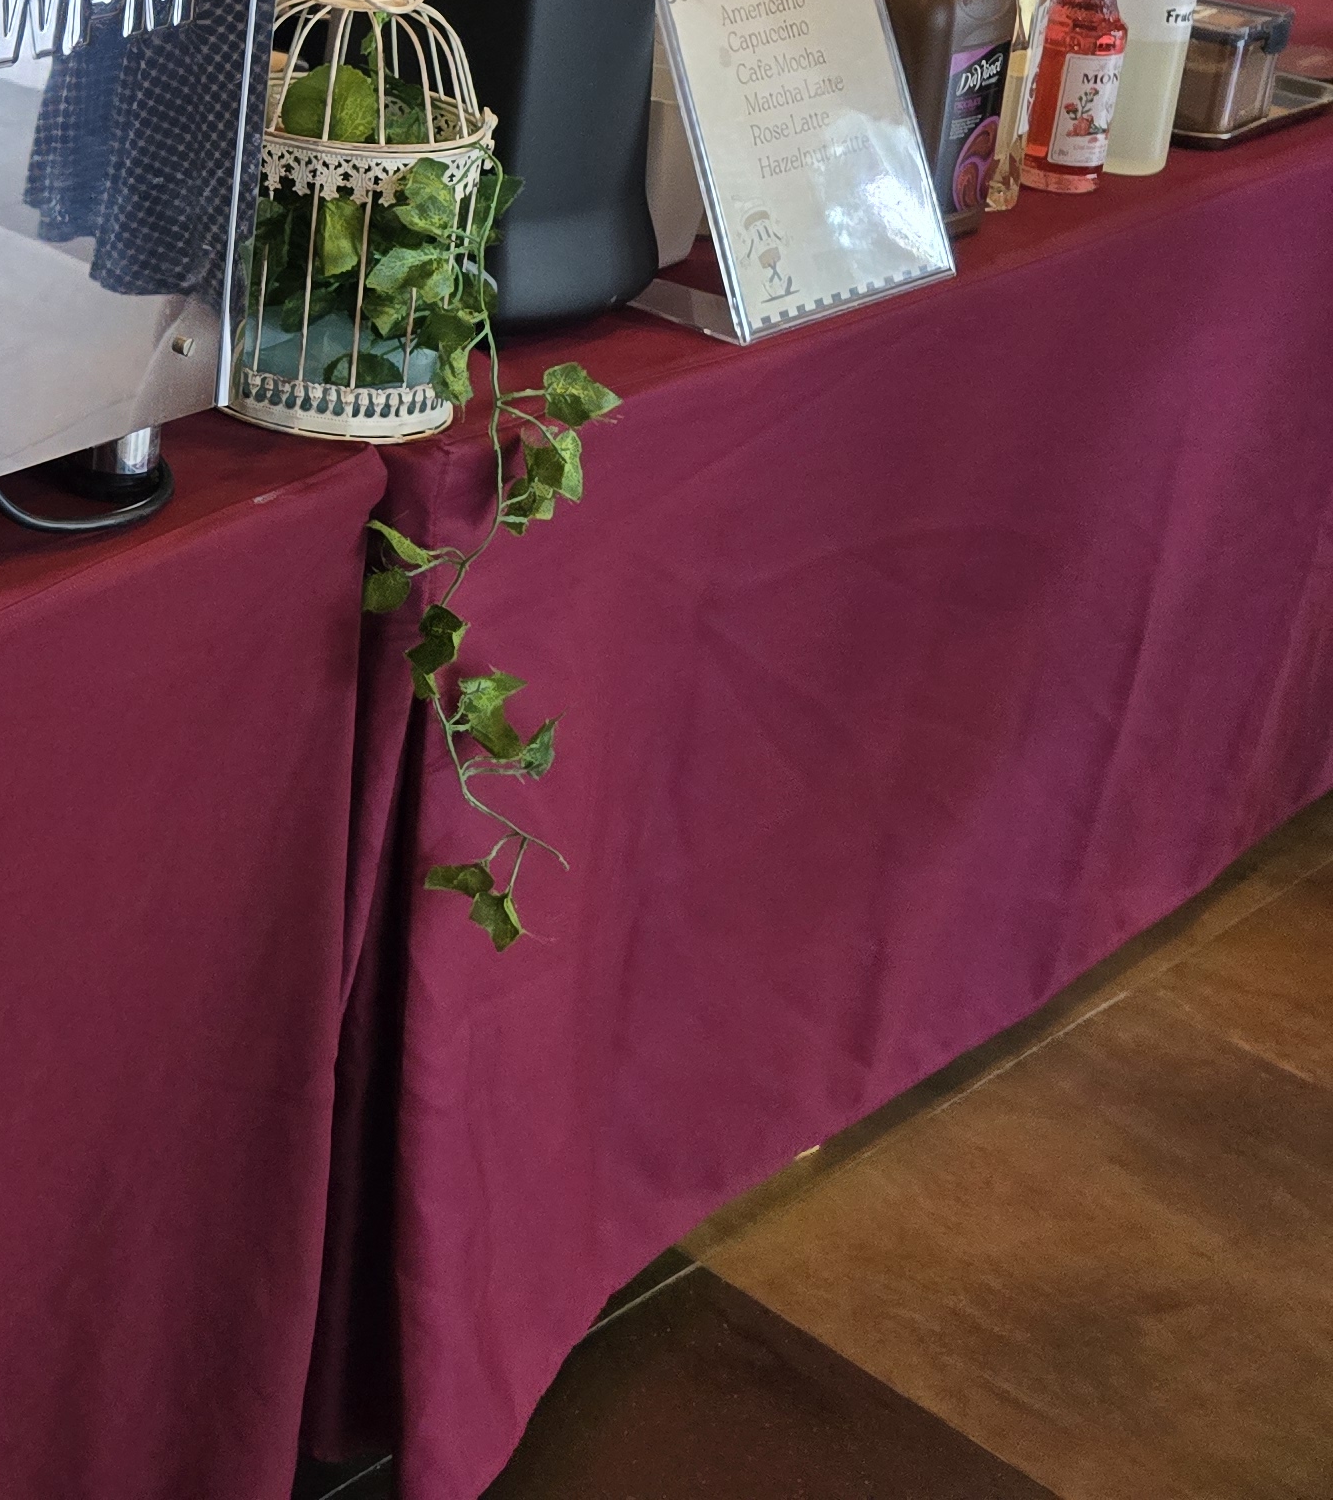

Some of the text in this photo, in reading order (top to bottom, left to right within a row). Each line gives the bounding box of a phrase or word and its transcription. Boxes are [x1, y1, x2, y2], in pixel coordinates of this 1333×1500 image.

[1166, 8, 1193, 24] Fruc
[727, 19, 809, 54] Capuccino
[736, 47, 827, 85] Cafe Mocha
[1082, 72, 1119, 85] MON
[744, 73, 845, 116] Matcha Latte
[750, 110, 830, 146] Rose Latte
[758, 145, 829, 179] Hazelnut
